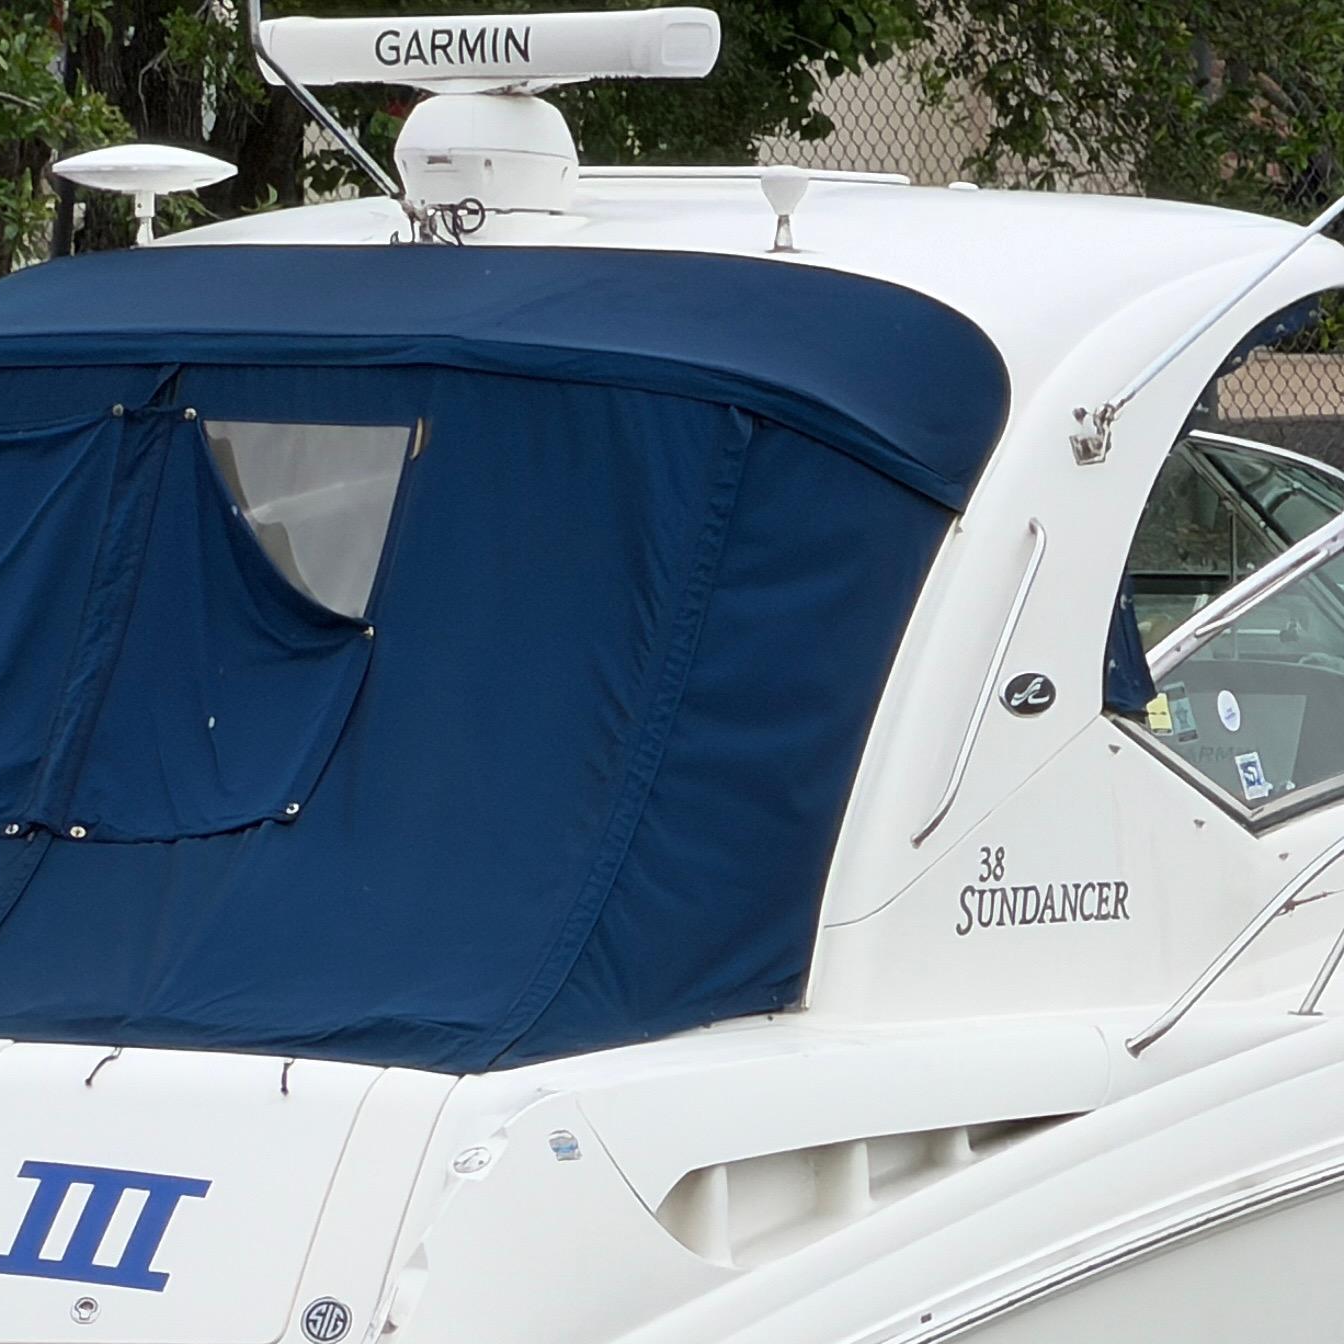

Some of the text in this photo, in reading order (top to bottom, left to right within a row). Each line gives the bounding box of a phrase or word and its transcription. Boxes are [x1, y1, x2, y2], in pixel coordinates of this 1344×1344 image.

[374, 26, 532, 67] GARMIN
[978, 846, 1006, 883] 38
[956, 880, 1131, 936] SUNDANCER
[306, 1300, 348, 1341] SIG
